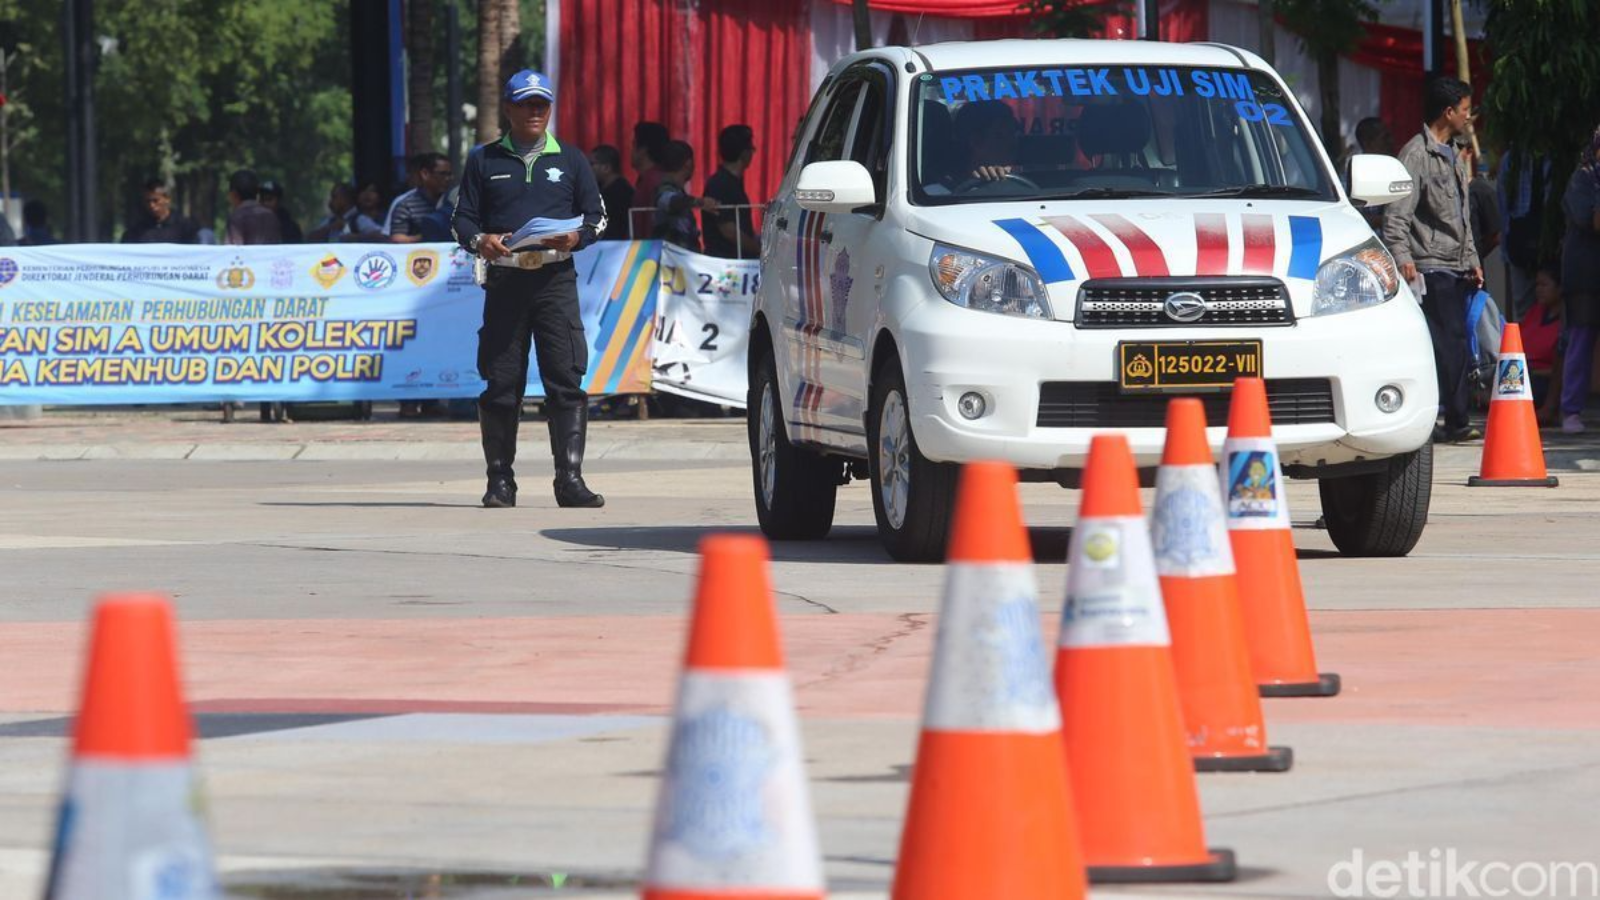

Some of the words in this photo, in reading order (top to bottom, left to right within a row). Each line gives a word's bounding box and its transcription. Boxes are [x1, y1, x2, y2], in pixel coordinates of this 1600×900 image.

[940, 68, 1118, 104] PRAKTEK
[1123, 68, 1184, 96] UJI
[1191, 70, 1256, 104] SIM
[1234, 100, 1294, 126] 02
[21, 272, 72, 281] DIREKTORAT
[73, 272, 115, 281] JENDERAL
[182, 272, 209, 280] DARAT
[11, 300, 134, 323] KESELAMATAN
[141, 298, 266, 321] PERHUBUNGAN
[273, 297, 329, 319] DARAT
[53, 325, 111, 355] SIM
[112, 325, 145, 354] A
[150, 323, 251, 353] UMUM
[256, 319, 416, 351] KOLEKTIF
[699, 323, 719, 351] 2
[35, 355, 208, 386] KEMENHUB
[213, 355, 285, 384] DAN
[290, 352, 383, 382] POLRI
[1159, 354, 1255, 374] 125022-VII
